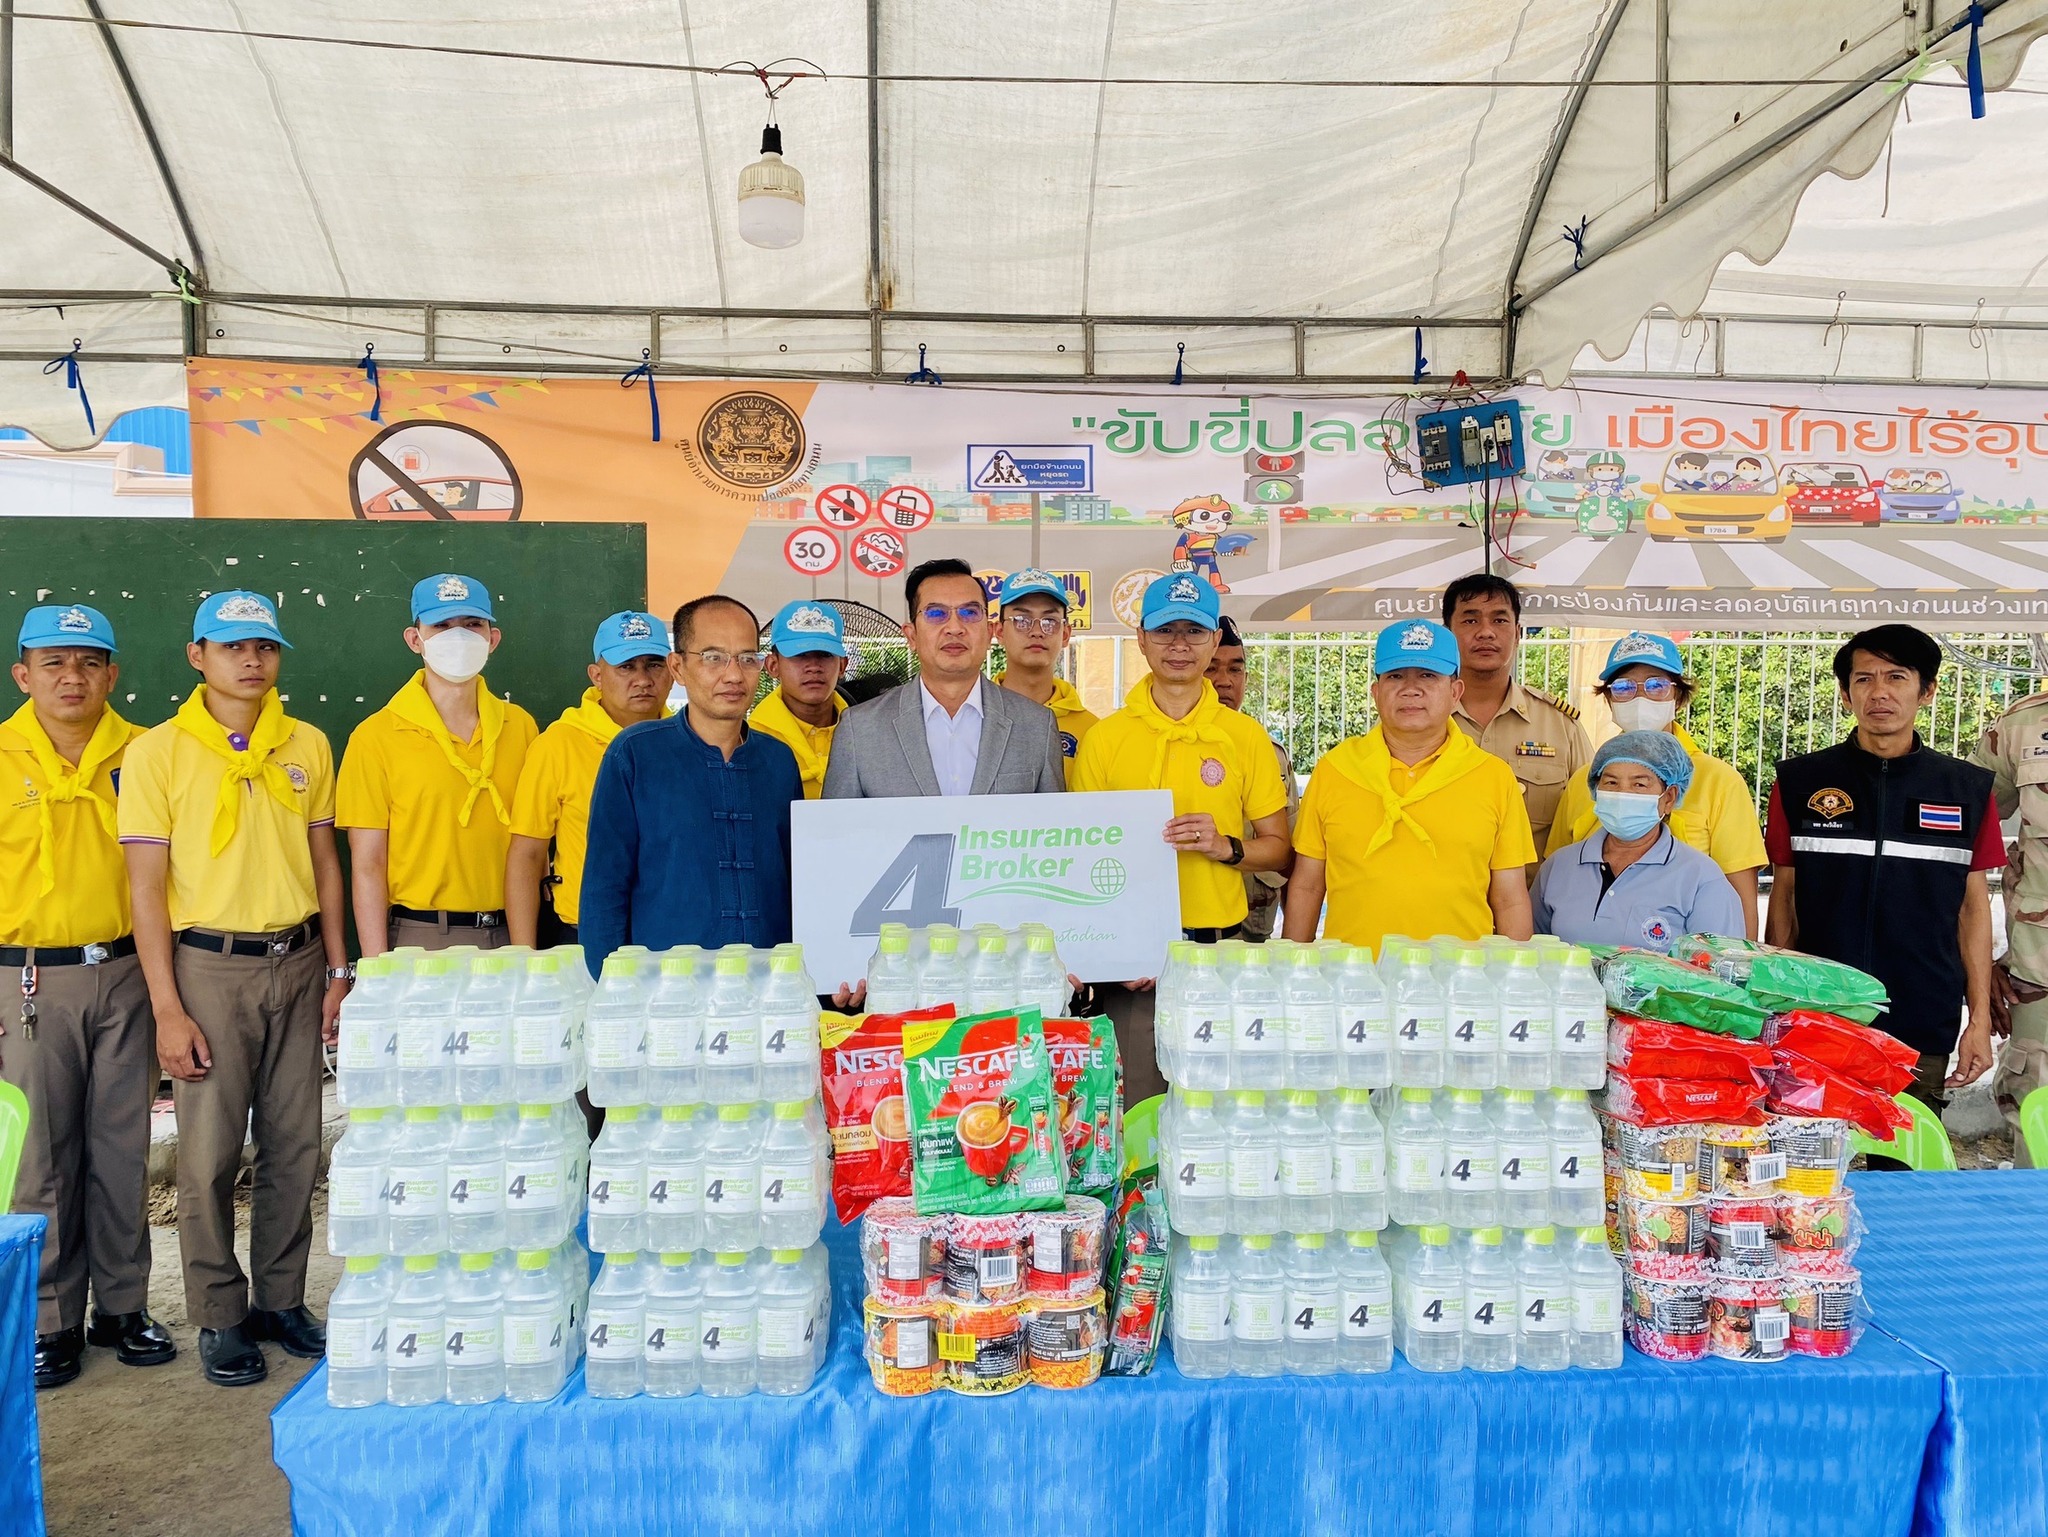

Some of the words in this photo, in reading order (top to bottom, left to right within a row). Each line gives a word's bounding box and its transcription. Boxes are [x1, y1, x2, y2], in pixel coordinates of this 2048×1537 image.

[1608, 404, 2048, 469] เมืองไทยไร้อุบ
[1021, 462, 1081, 470] ยกมือข้ามถนน
[1707, 526, 1728, 535] 1784
[795, 542, 826, 558] 30
[959, 825, 1124, 850] Insurance
[959, 853, 1074, 880] Broker
[849, 833, 963, 937] 4
[1053, 925, 1118, 943] ustodian
[559, 1027, 571, 1051] 4
[765, 1029, 786, 1053] 4
[1193, 1020, 1213, 1043] 4
[1245, 1018, 1265, 1041] 4
[1346, 1020, 1367, 1043] 4
[1399, 1018, 1419, 1041] 4
[1454, 1020, 1475, 1043] 4
[1508, 1019, 1529, 1042] 4
[1565, 1020, 1586, 1043] 4
[708, 1031, 729, 1055] 4
[835, 1046, 900, 1075] NESC
[856, 1077, 889, 1088] BLEND
[940, 1081, 974, 1094] BLEND
[978, 1081, 984, 1089] &
[988, 1078, 1018, 1088] BREW
[1179, 1163, 1197, 1186] 4
[1451, 1158, 1472, 1182] 4
[1501, 1157, 1522, 1181] 4
[1559, 1156, 1580, 1179] 4
[389, 1181, 406, 1206] 4
[449, 1179, 469, 1204] 4
[507, 1175, 527, 1199] 4
[591, 1180, 610, 1204] 4
[649, 1180, 668, 1204] 4
[706, 1179, 724, 1203] 4
[764, 1179, 783, 1203] 4
[1294, 1307, 1315, 1331] 4
[1348, 1304, 1369, 1328] 4
[1422, 1299, 1444, 1323] 4
[1474, 1302, 1495, 1325] 4
[1525, 1298, 1546, 1322] 4
[549, 1322, 562, 1348] 4
[589, 1323, 608, 1349] 4
[646, 1327, 665, 1352] 4
[702, 1326, 721, 1351] 4
[803, 1316, 815, 1343] 4
[396, 1333, 417, 1358] 4
[446, 1331, 464, 1356] 4
